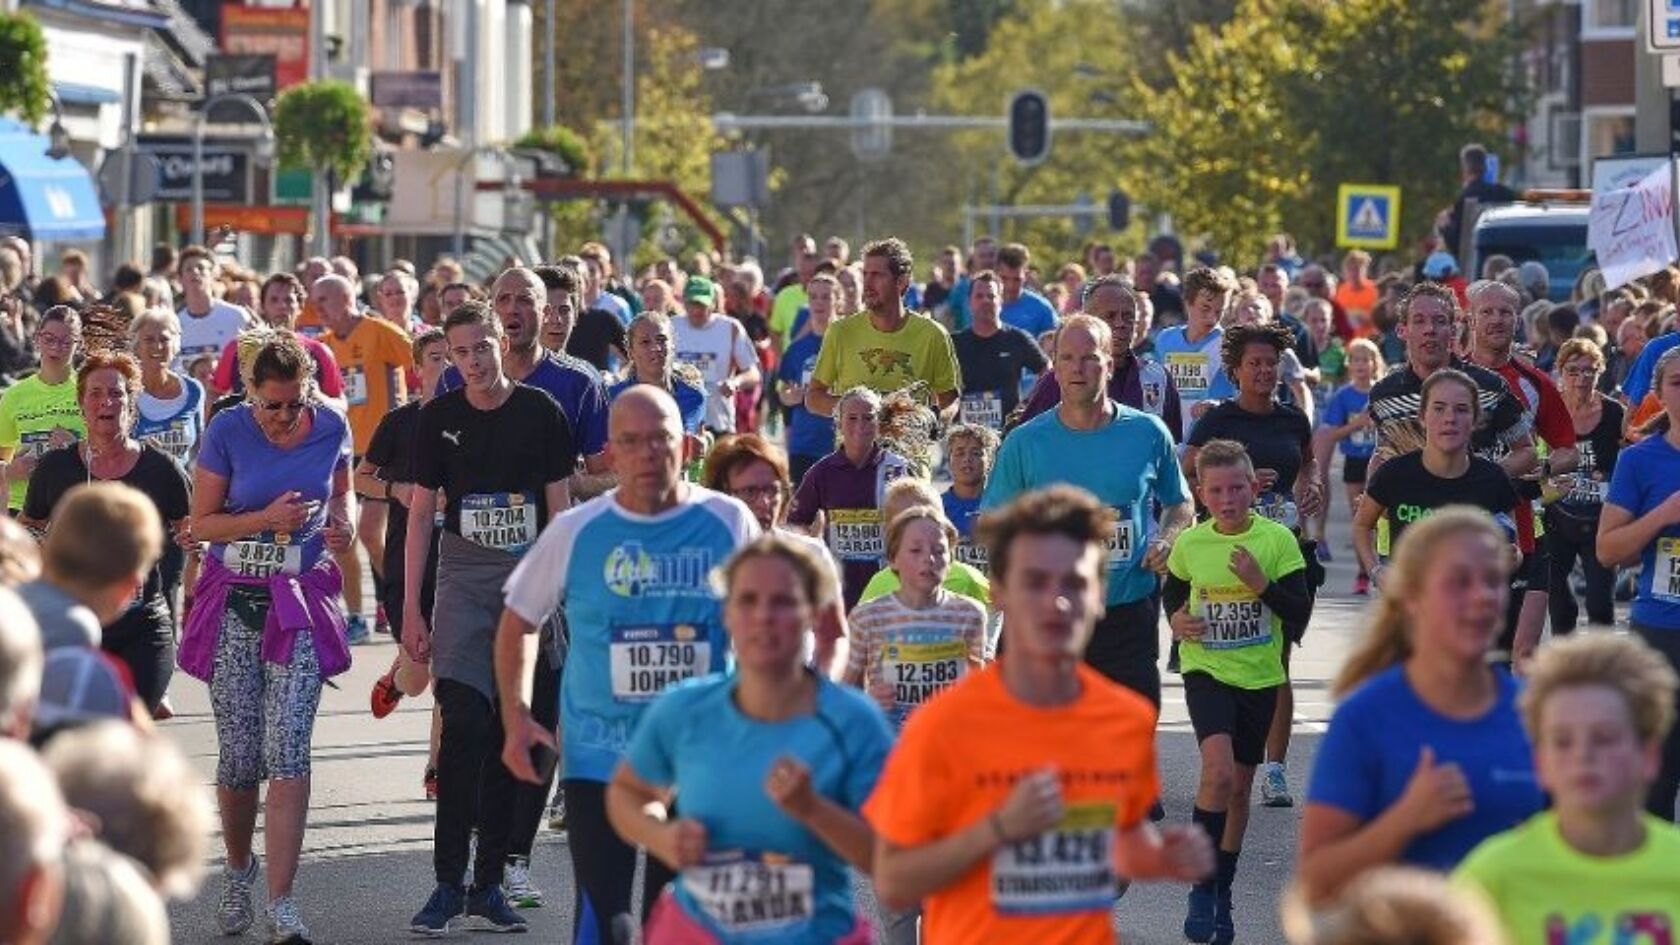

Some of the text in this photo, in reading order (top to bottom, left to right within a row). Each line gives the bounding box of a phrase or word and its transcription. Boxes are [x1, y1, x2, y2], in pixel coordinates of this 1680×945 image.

[471, 507, 526, 527] 10.204
[471, 526, 528, 545] KYLIAN
[239, 542, 286, 563] 9.828
[1206, 601, 1262, 621] 12.359
[1209, 620, 1260, 641] TWAN
[627, 644, 696, 667] 10.790
[895, 660, 958, 683] 12.583
[896, 682, 952, 704] DAN
